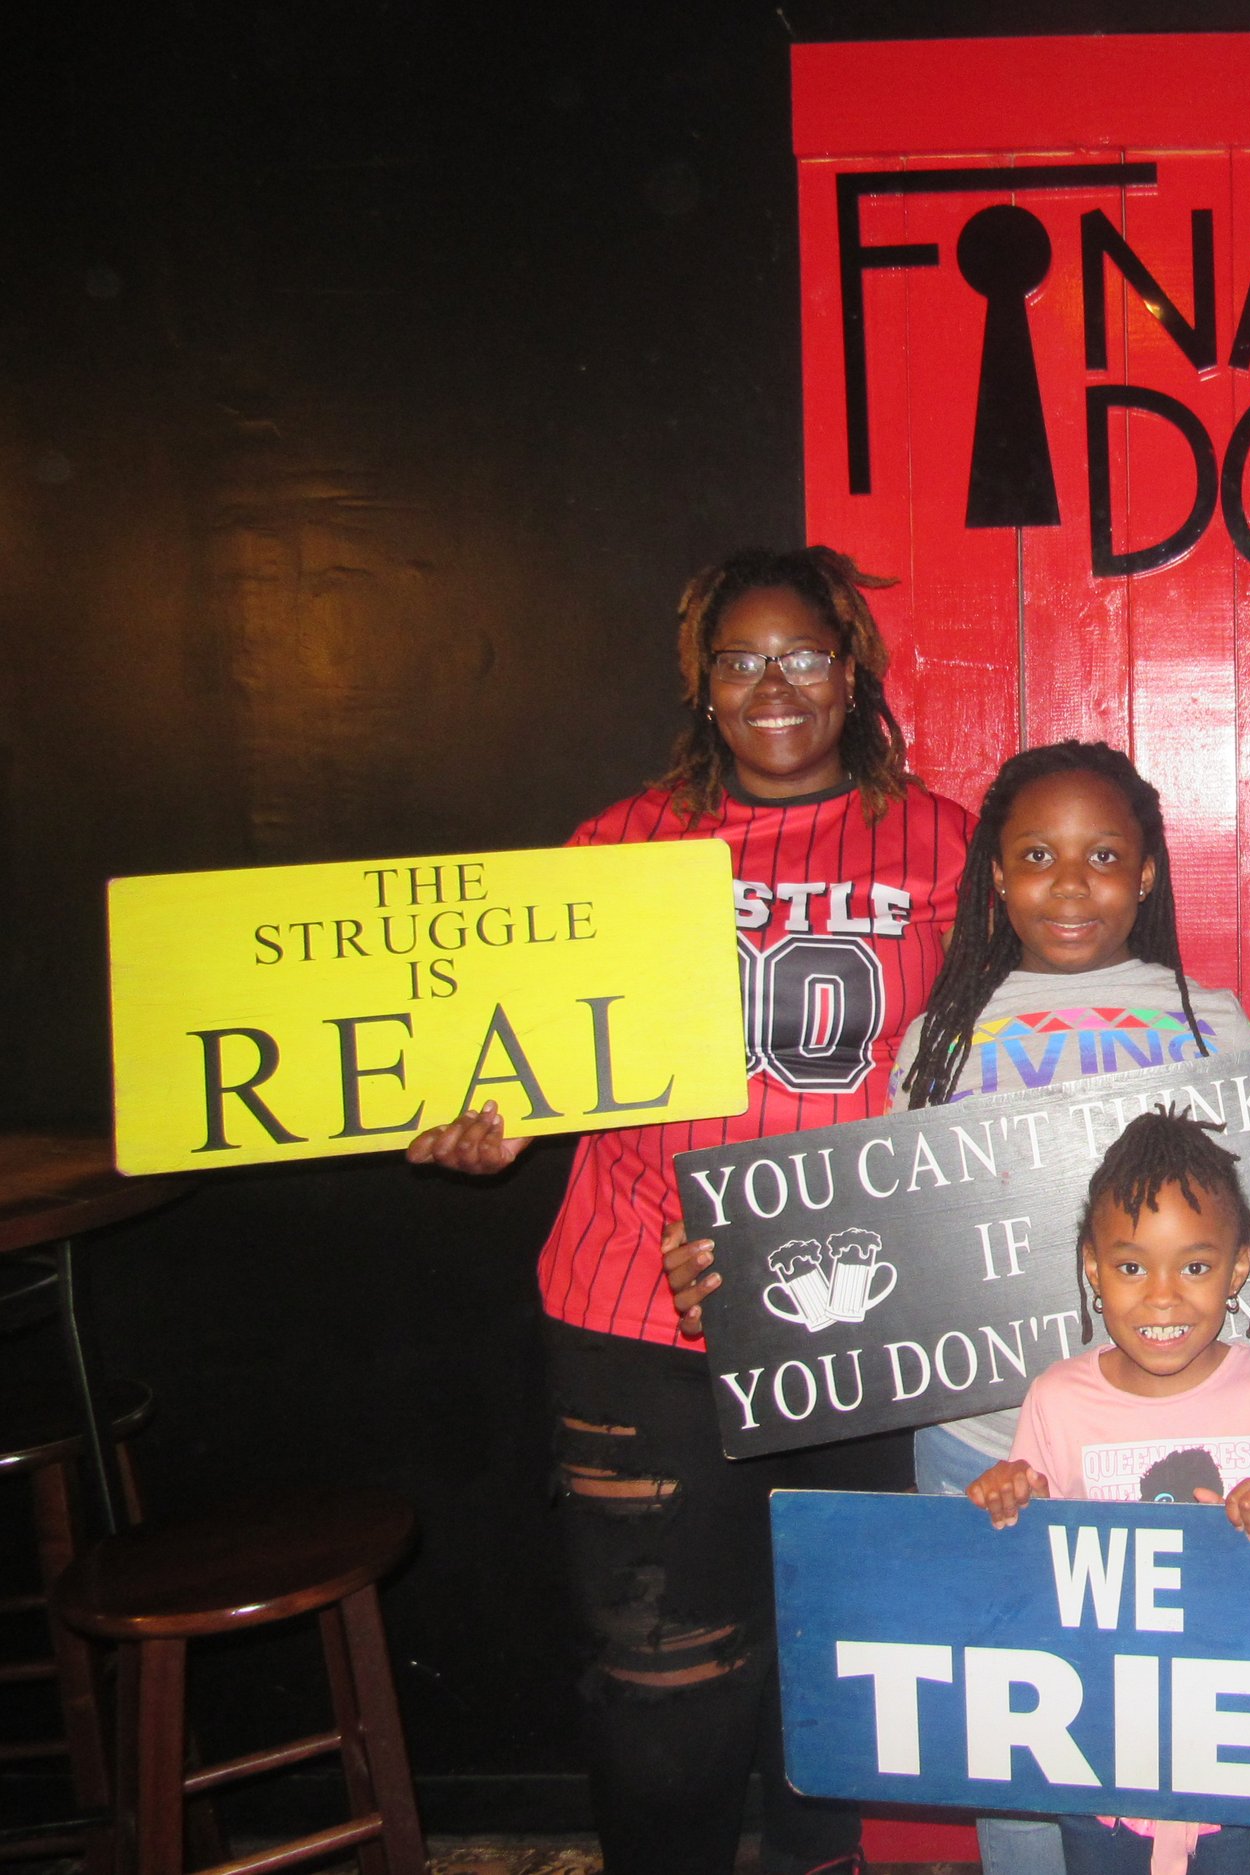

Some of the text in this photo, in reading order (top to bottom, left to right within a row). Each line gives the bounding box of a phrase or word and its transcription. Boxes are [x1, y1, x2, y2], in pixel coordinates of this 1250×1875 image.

[364, 863, 488, 908] THE
[254, 901, 598, 966] STRUGGLE
[408, 958, 458, 1001] IS
[186, 995, 674, 1154] REAL
[691, 1142, 835, 1228] YOU
[857, 1112, 1048, 1199] CAN'T
[974, 1216, 1033, 1282] IF
[719, 1311, 1081, 1431] YOU DON'T
[1047, 1525, 1185, 1632] WE
